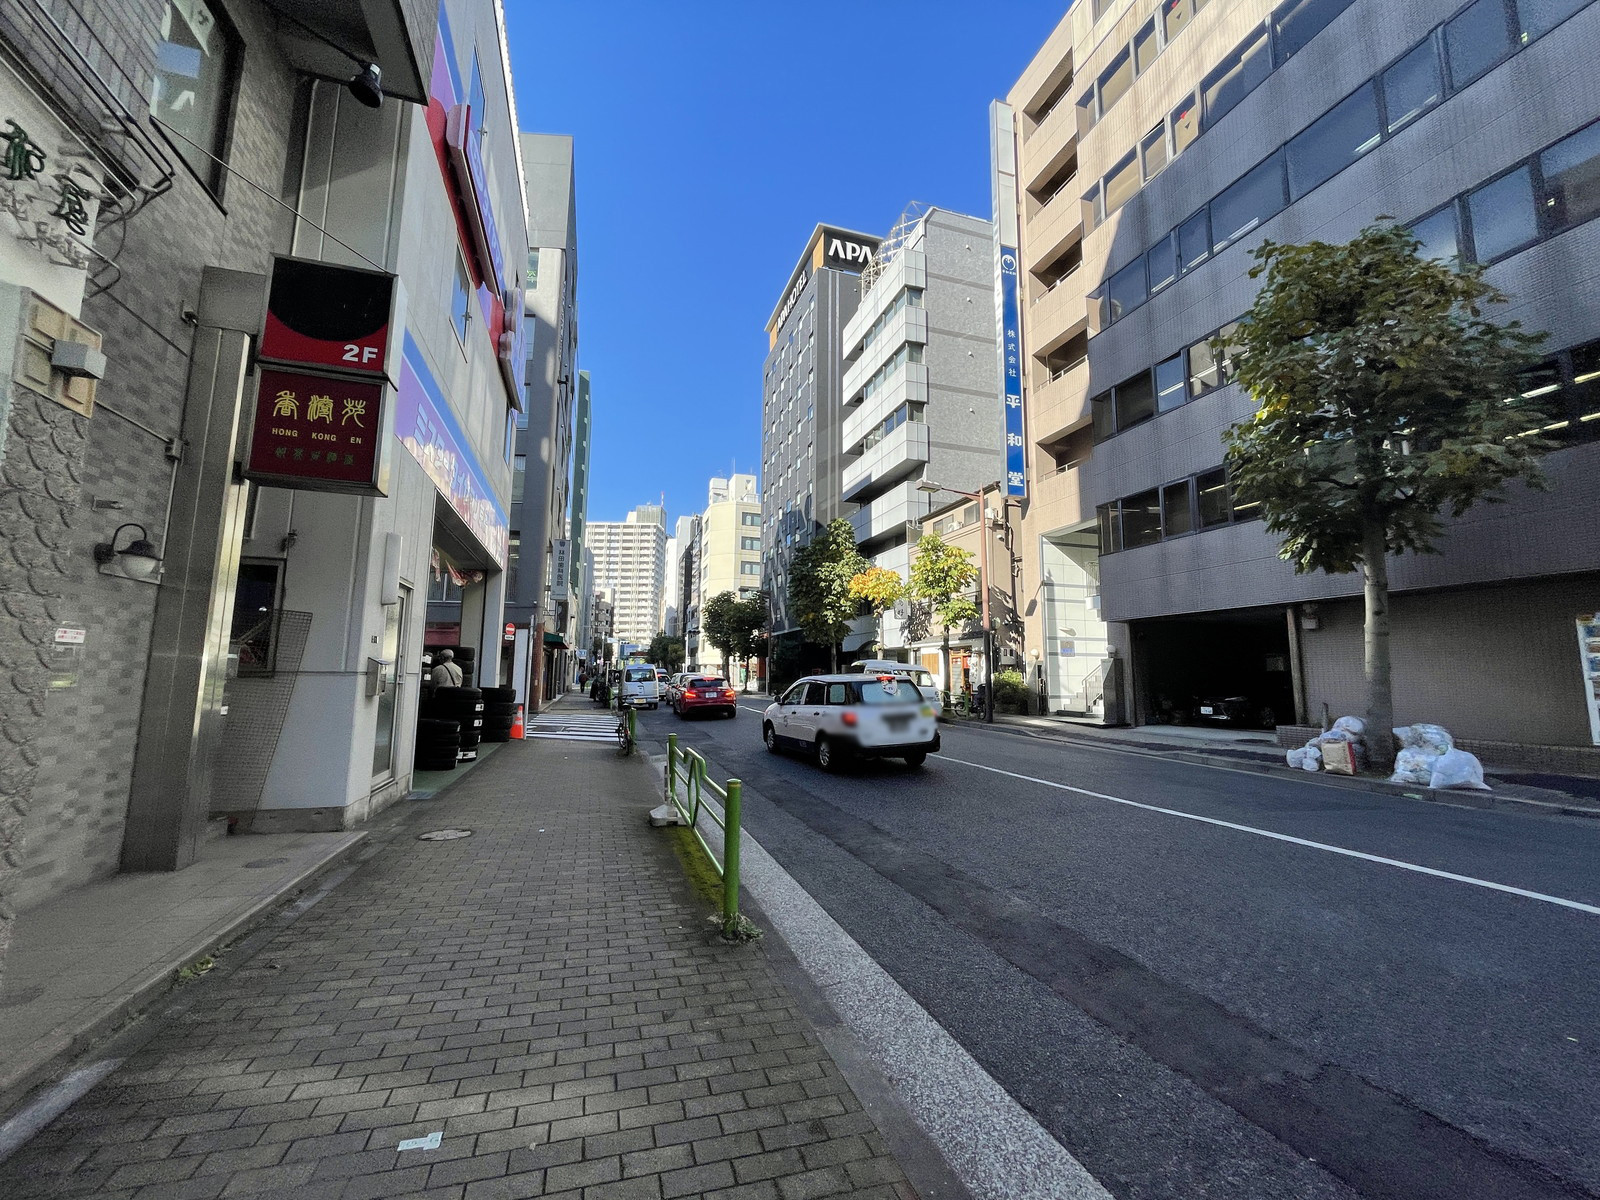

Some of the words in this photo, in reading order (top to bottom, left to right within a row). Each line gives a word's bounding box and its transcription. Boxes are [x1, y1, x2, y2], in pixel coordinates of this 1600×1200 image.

[828, 238, 872, 263] APA
[787, 270, 808, 311] HOTEL
[342, 344, 378, 363] 2F
[272, 427, 298, 437] HONG
[312, 432, 337, 441] KONG
[350, 436, 362, 444] EN
[1005, 394, 1024, 487] 平和堂
